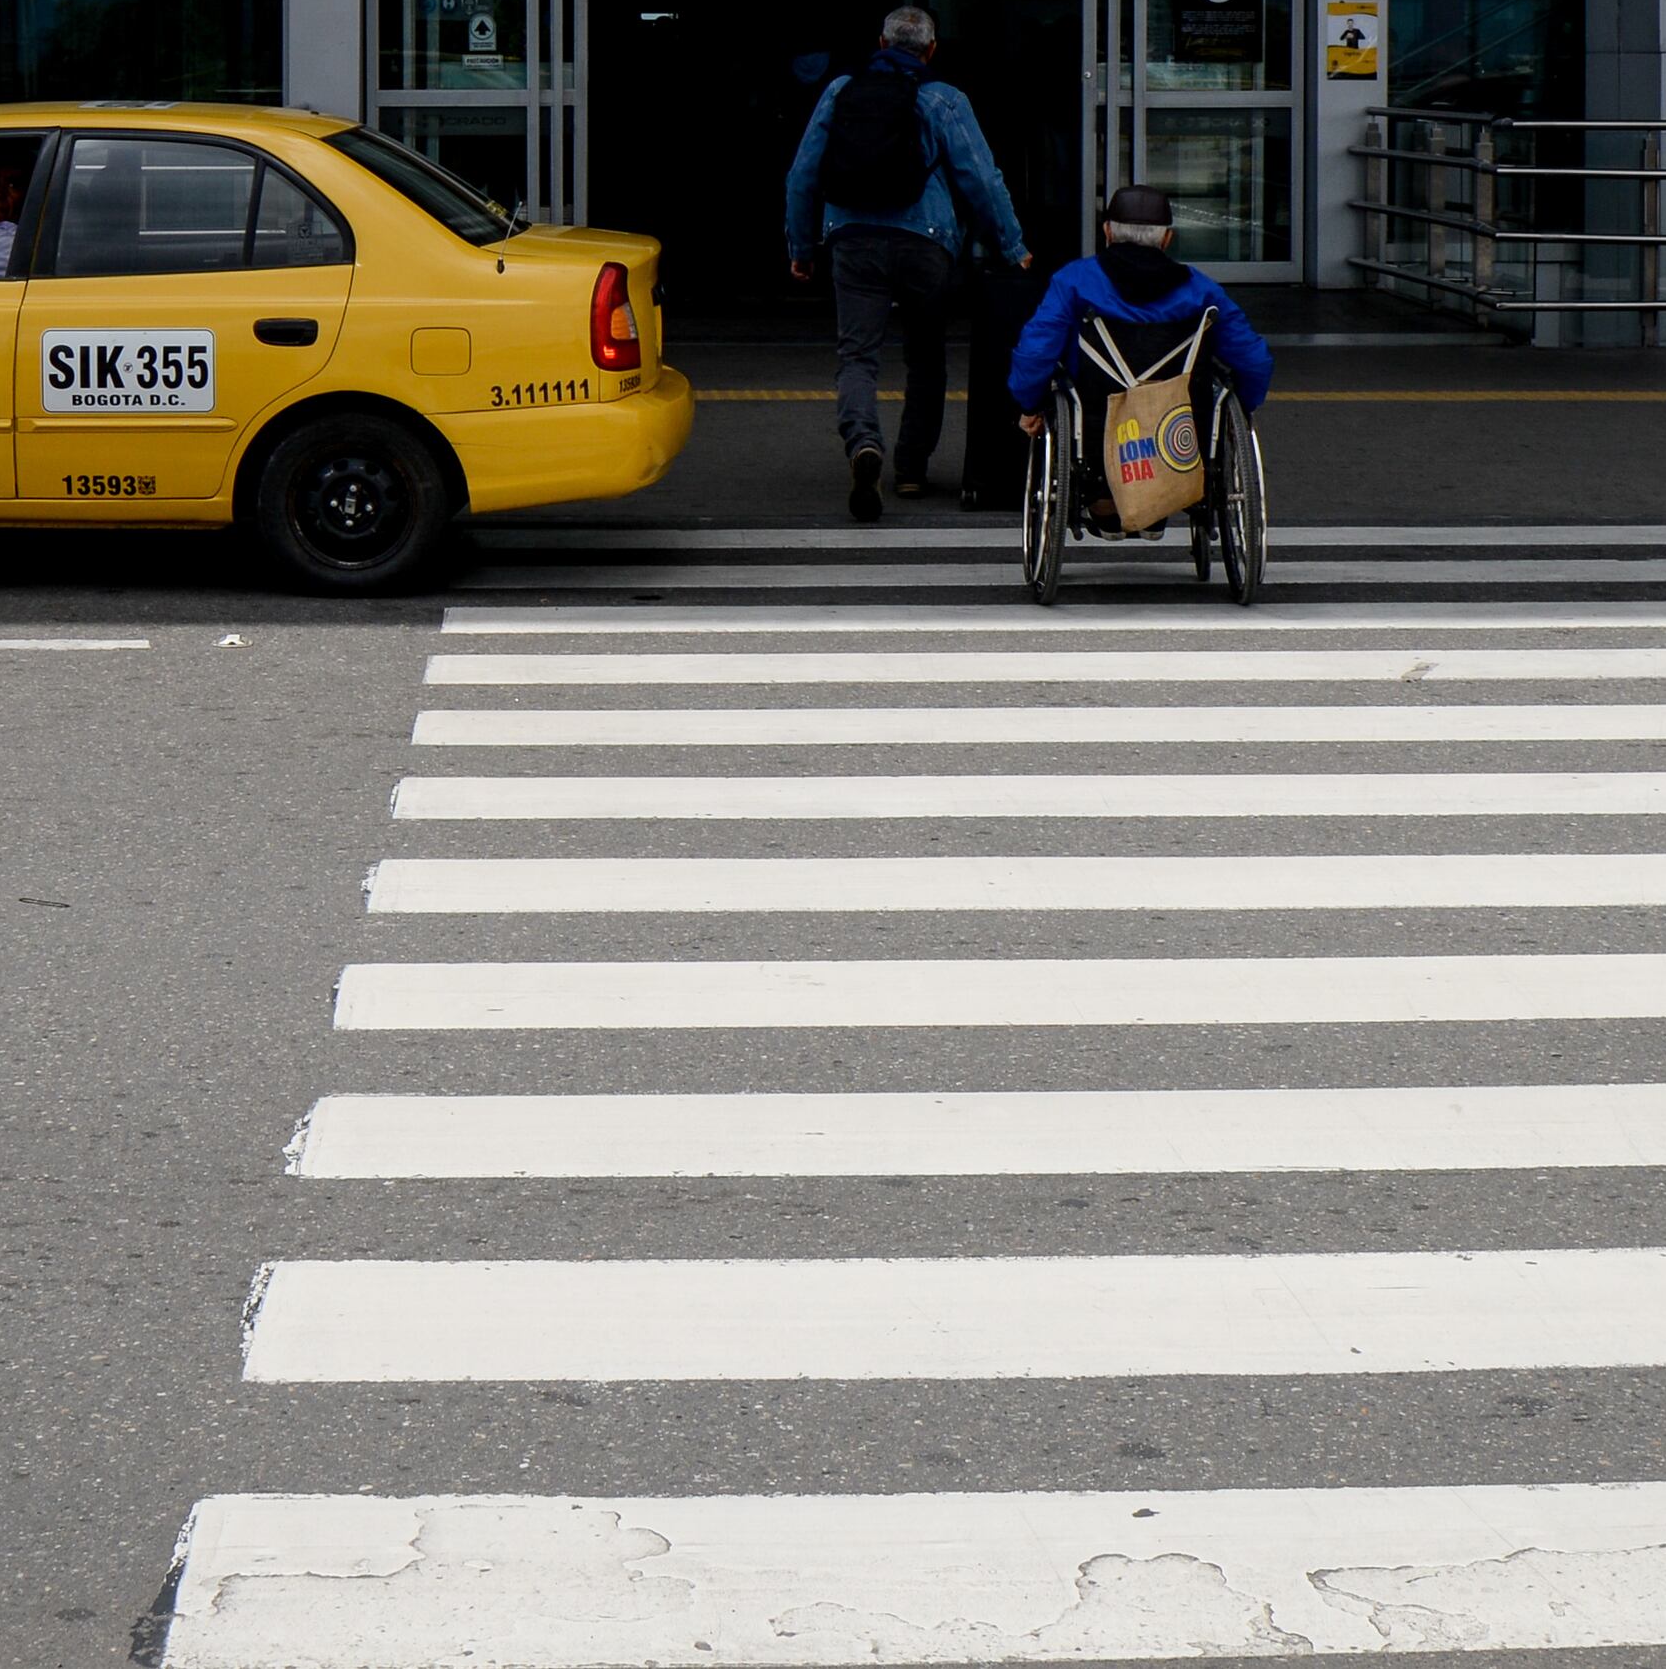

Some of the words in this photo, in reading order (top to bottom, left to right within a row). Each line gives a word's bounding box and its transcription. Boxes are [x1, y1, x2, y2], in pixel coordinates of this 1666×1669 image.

[48, 344, 125, 390] SIK
[137, 345, 209, 390] 355
[72, 394, 144, 406] BOGOTA
[149, 394, 186, 406] D.C.
[490, 378, 589, 407] 3.111111
[1116, 418, 1139, 443] CO
[1119, 437, 1156, 463] LOM
[1121, 460, 1154, 484] BIA
[62, 474, 137, 496] 13593
